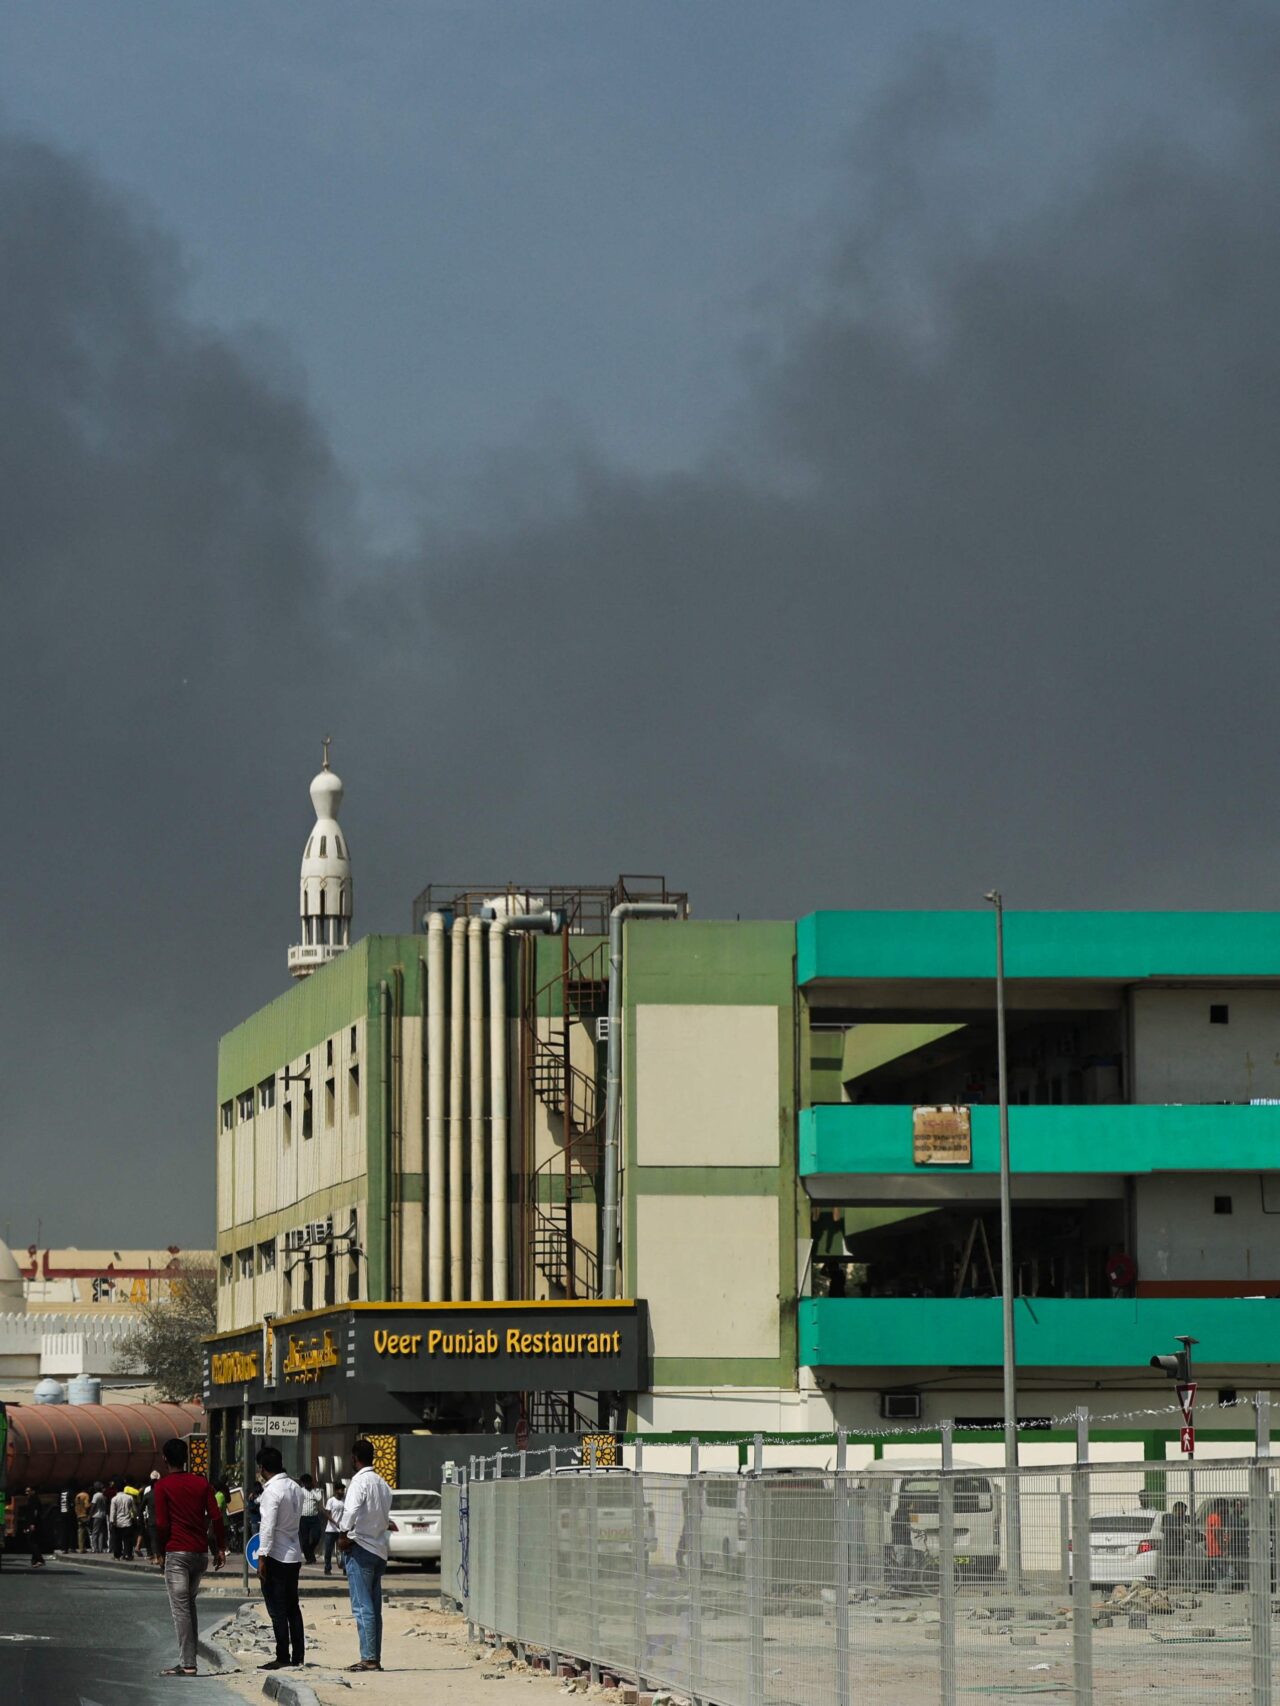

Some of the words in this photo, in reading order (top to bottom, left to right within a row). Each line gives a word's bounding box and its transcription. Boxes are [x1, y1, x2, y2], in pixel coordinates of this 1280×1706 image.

[373, 1329, 421, 1354] Veer
[428, 1328, 499, 1354] Punjab
[506, 1328, 621, 1353] Restaurant
[269, 1421, 280, 1430] 26
